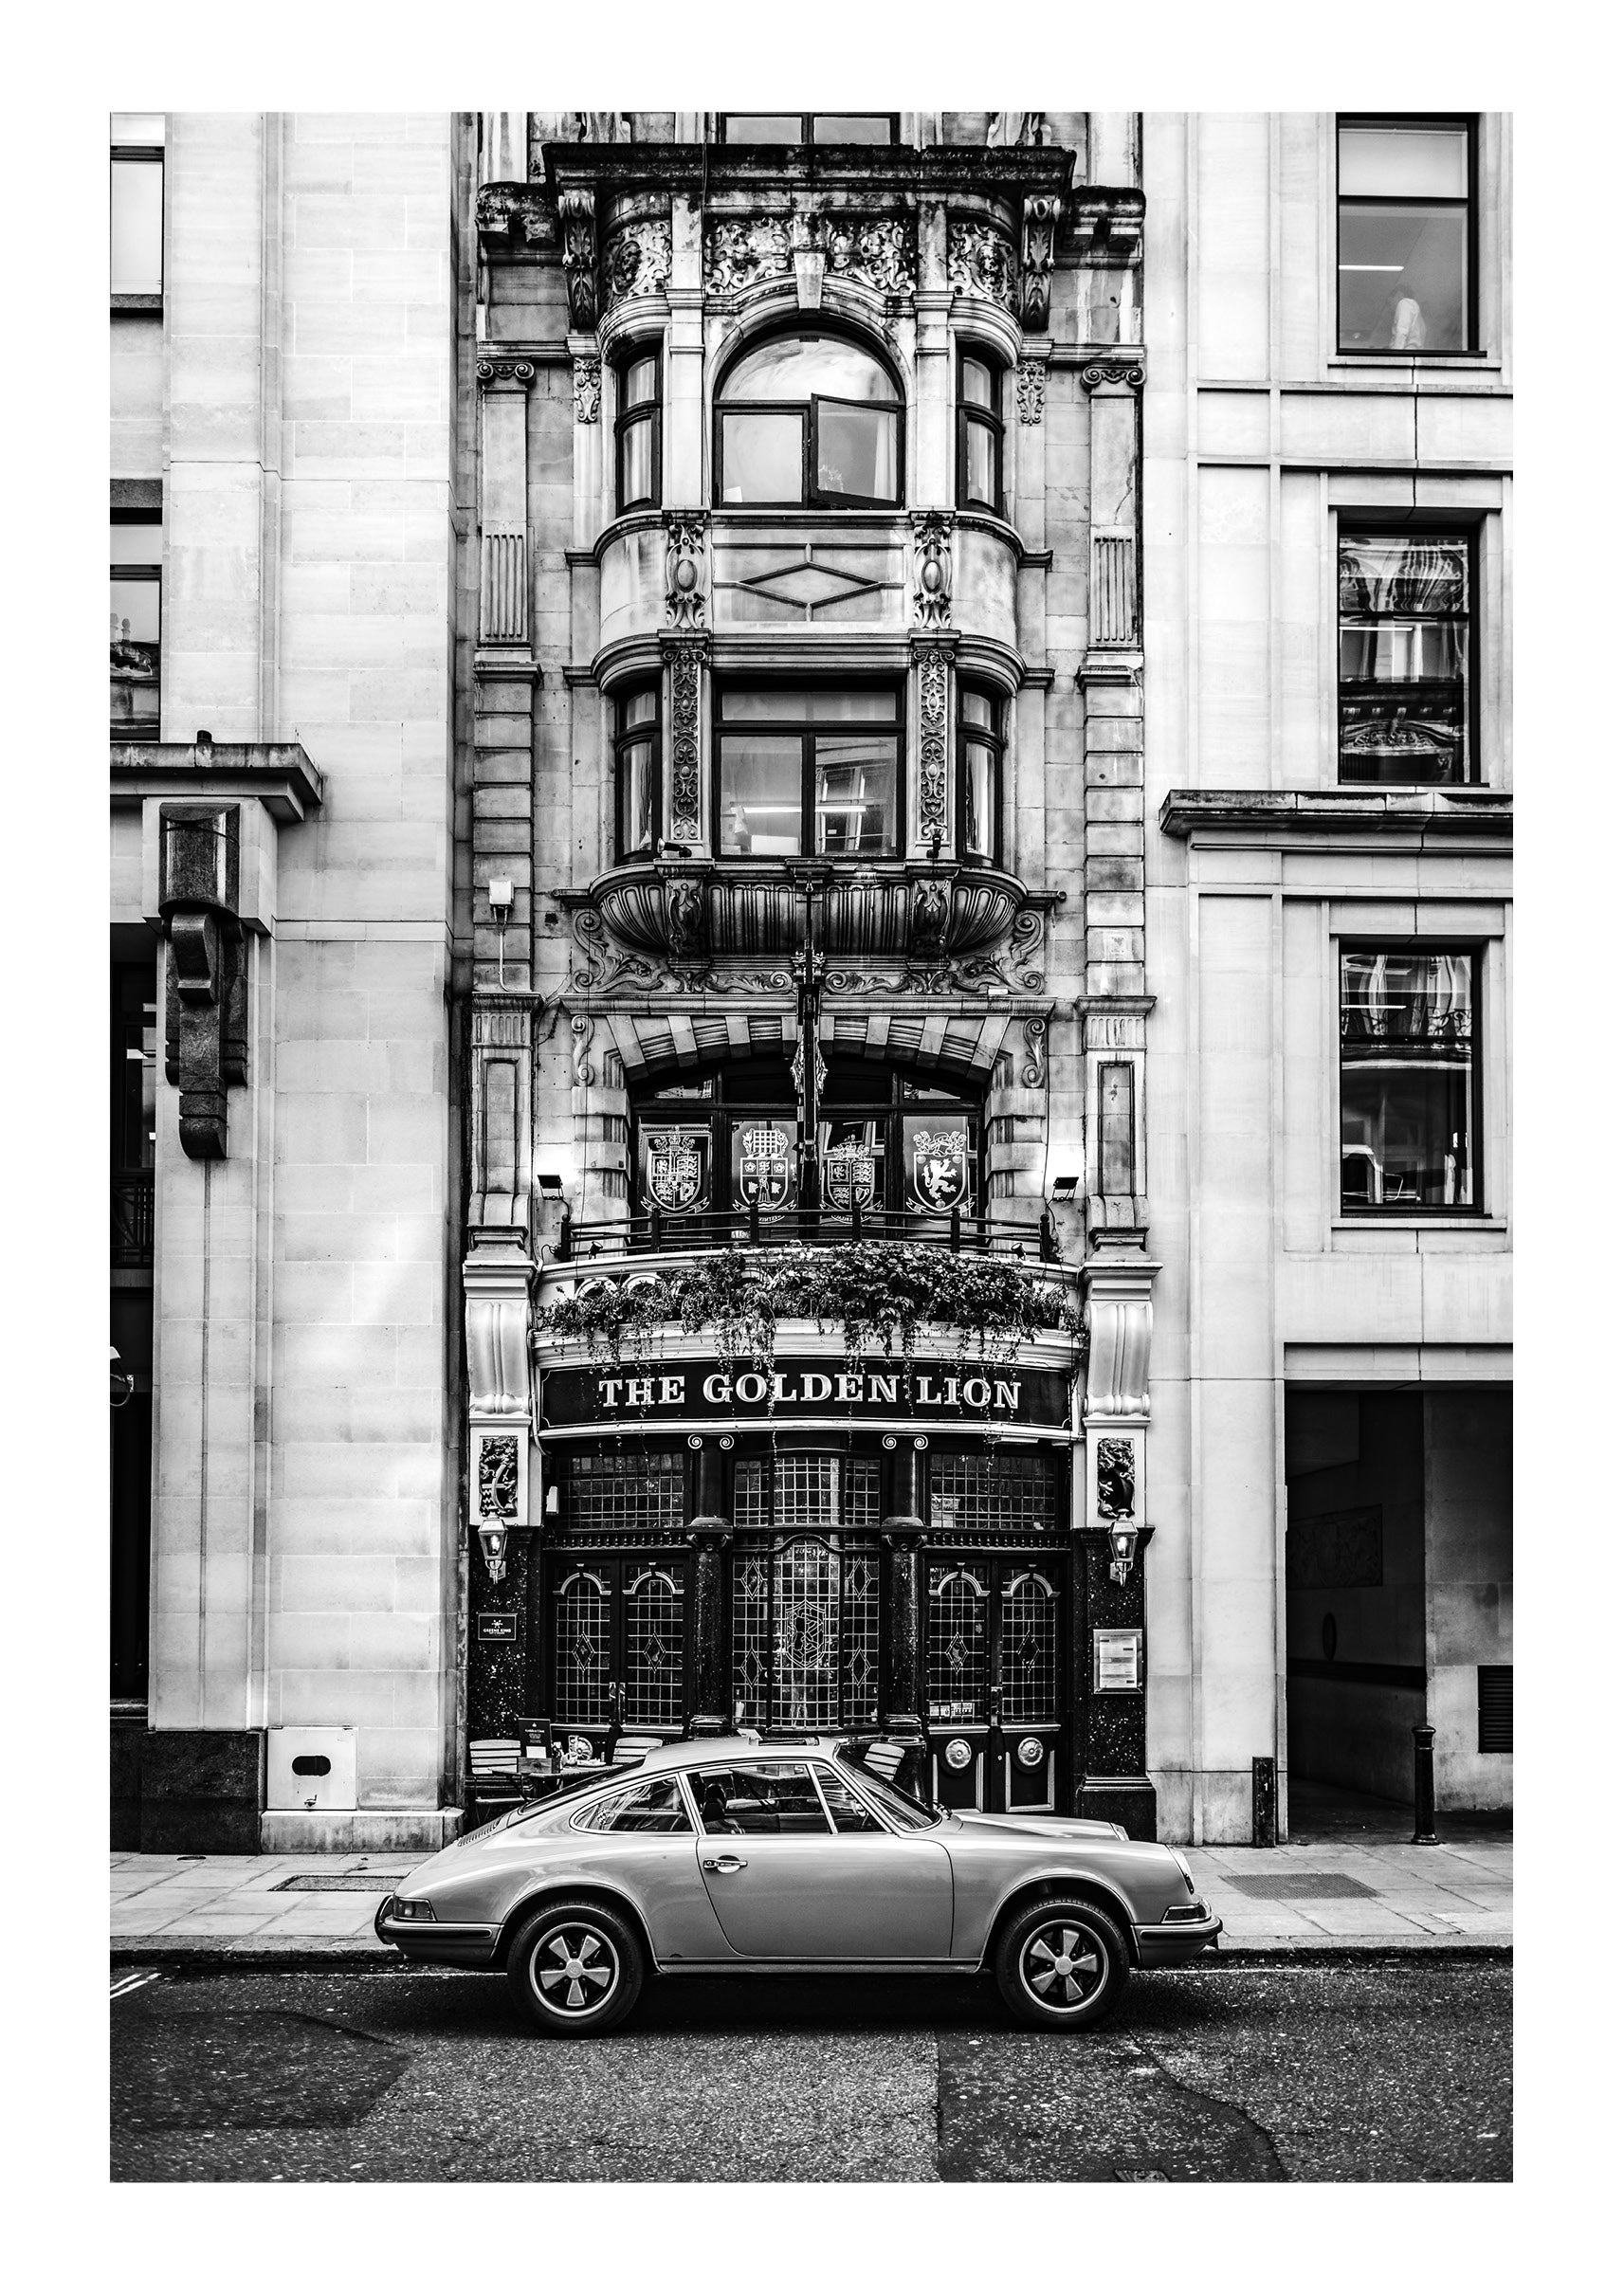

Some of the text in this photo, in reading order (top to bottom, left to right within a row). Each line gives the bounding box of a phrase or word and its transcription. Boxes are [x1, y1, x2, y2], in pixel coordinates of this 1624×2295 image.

[598, 1373, 1022, 1410] THE GOLDEN LION
